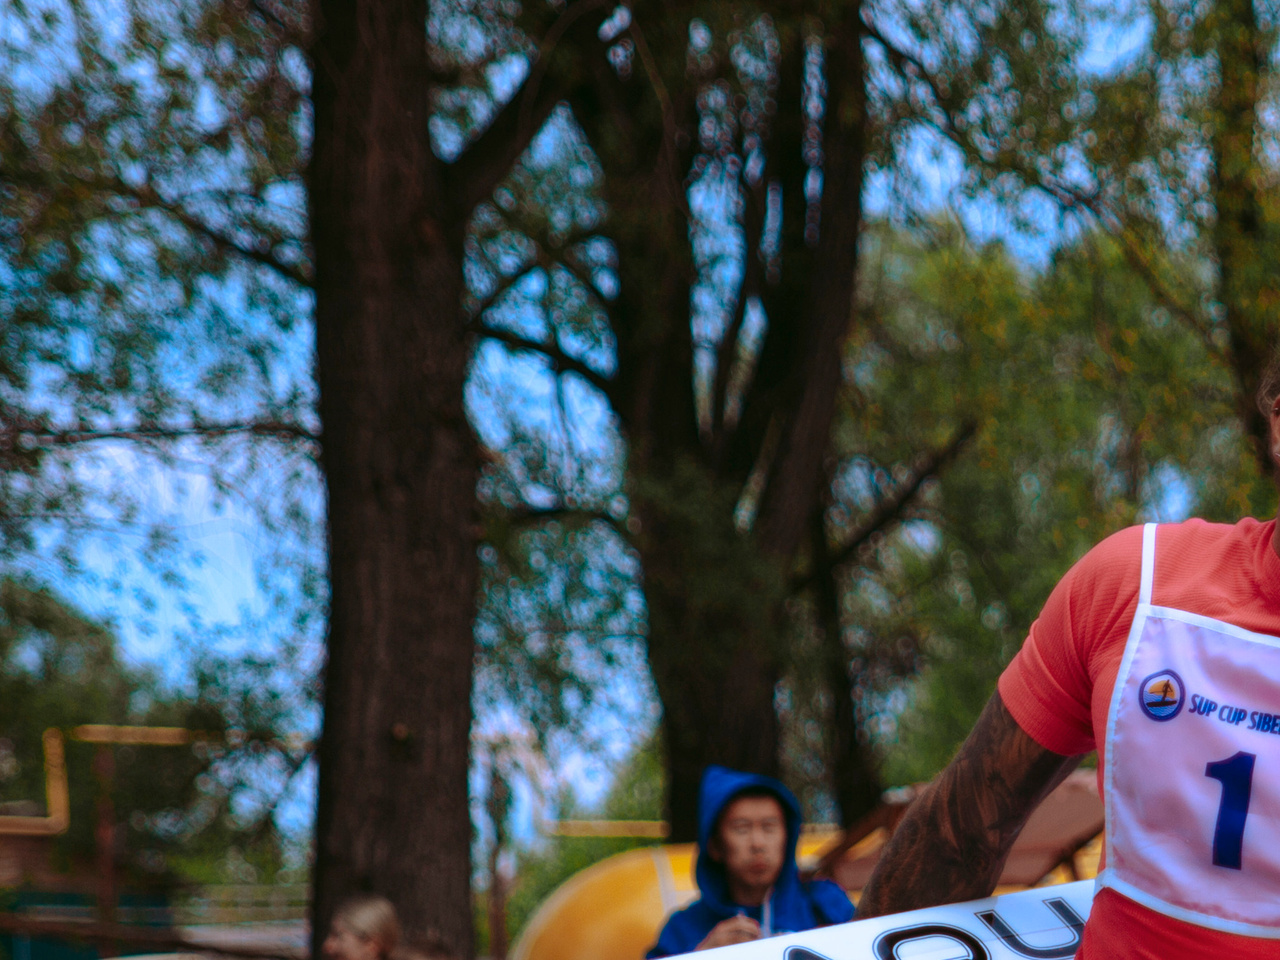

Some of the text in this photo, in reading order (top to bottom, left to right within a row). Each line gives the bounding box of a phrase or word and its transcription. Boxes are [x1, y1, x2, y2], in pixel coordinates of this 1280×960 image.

[1188, 693, 1218, 717] SUP
[1218, 704, 1247, 726] CUP
[1204, 750, 1257, 871] 1
